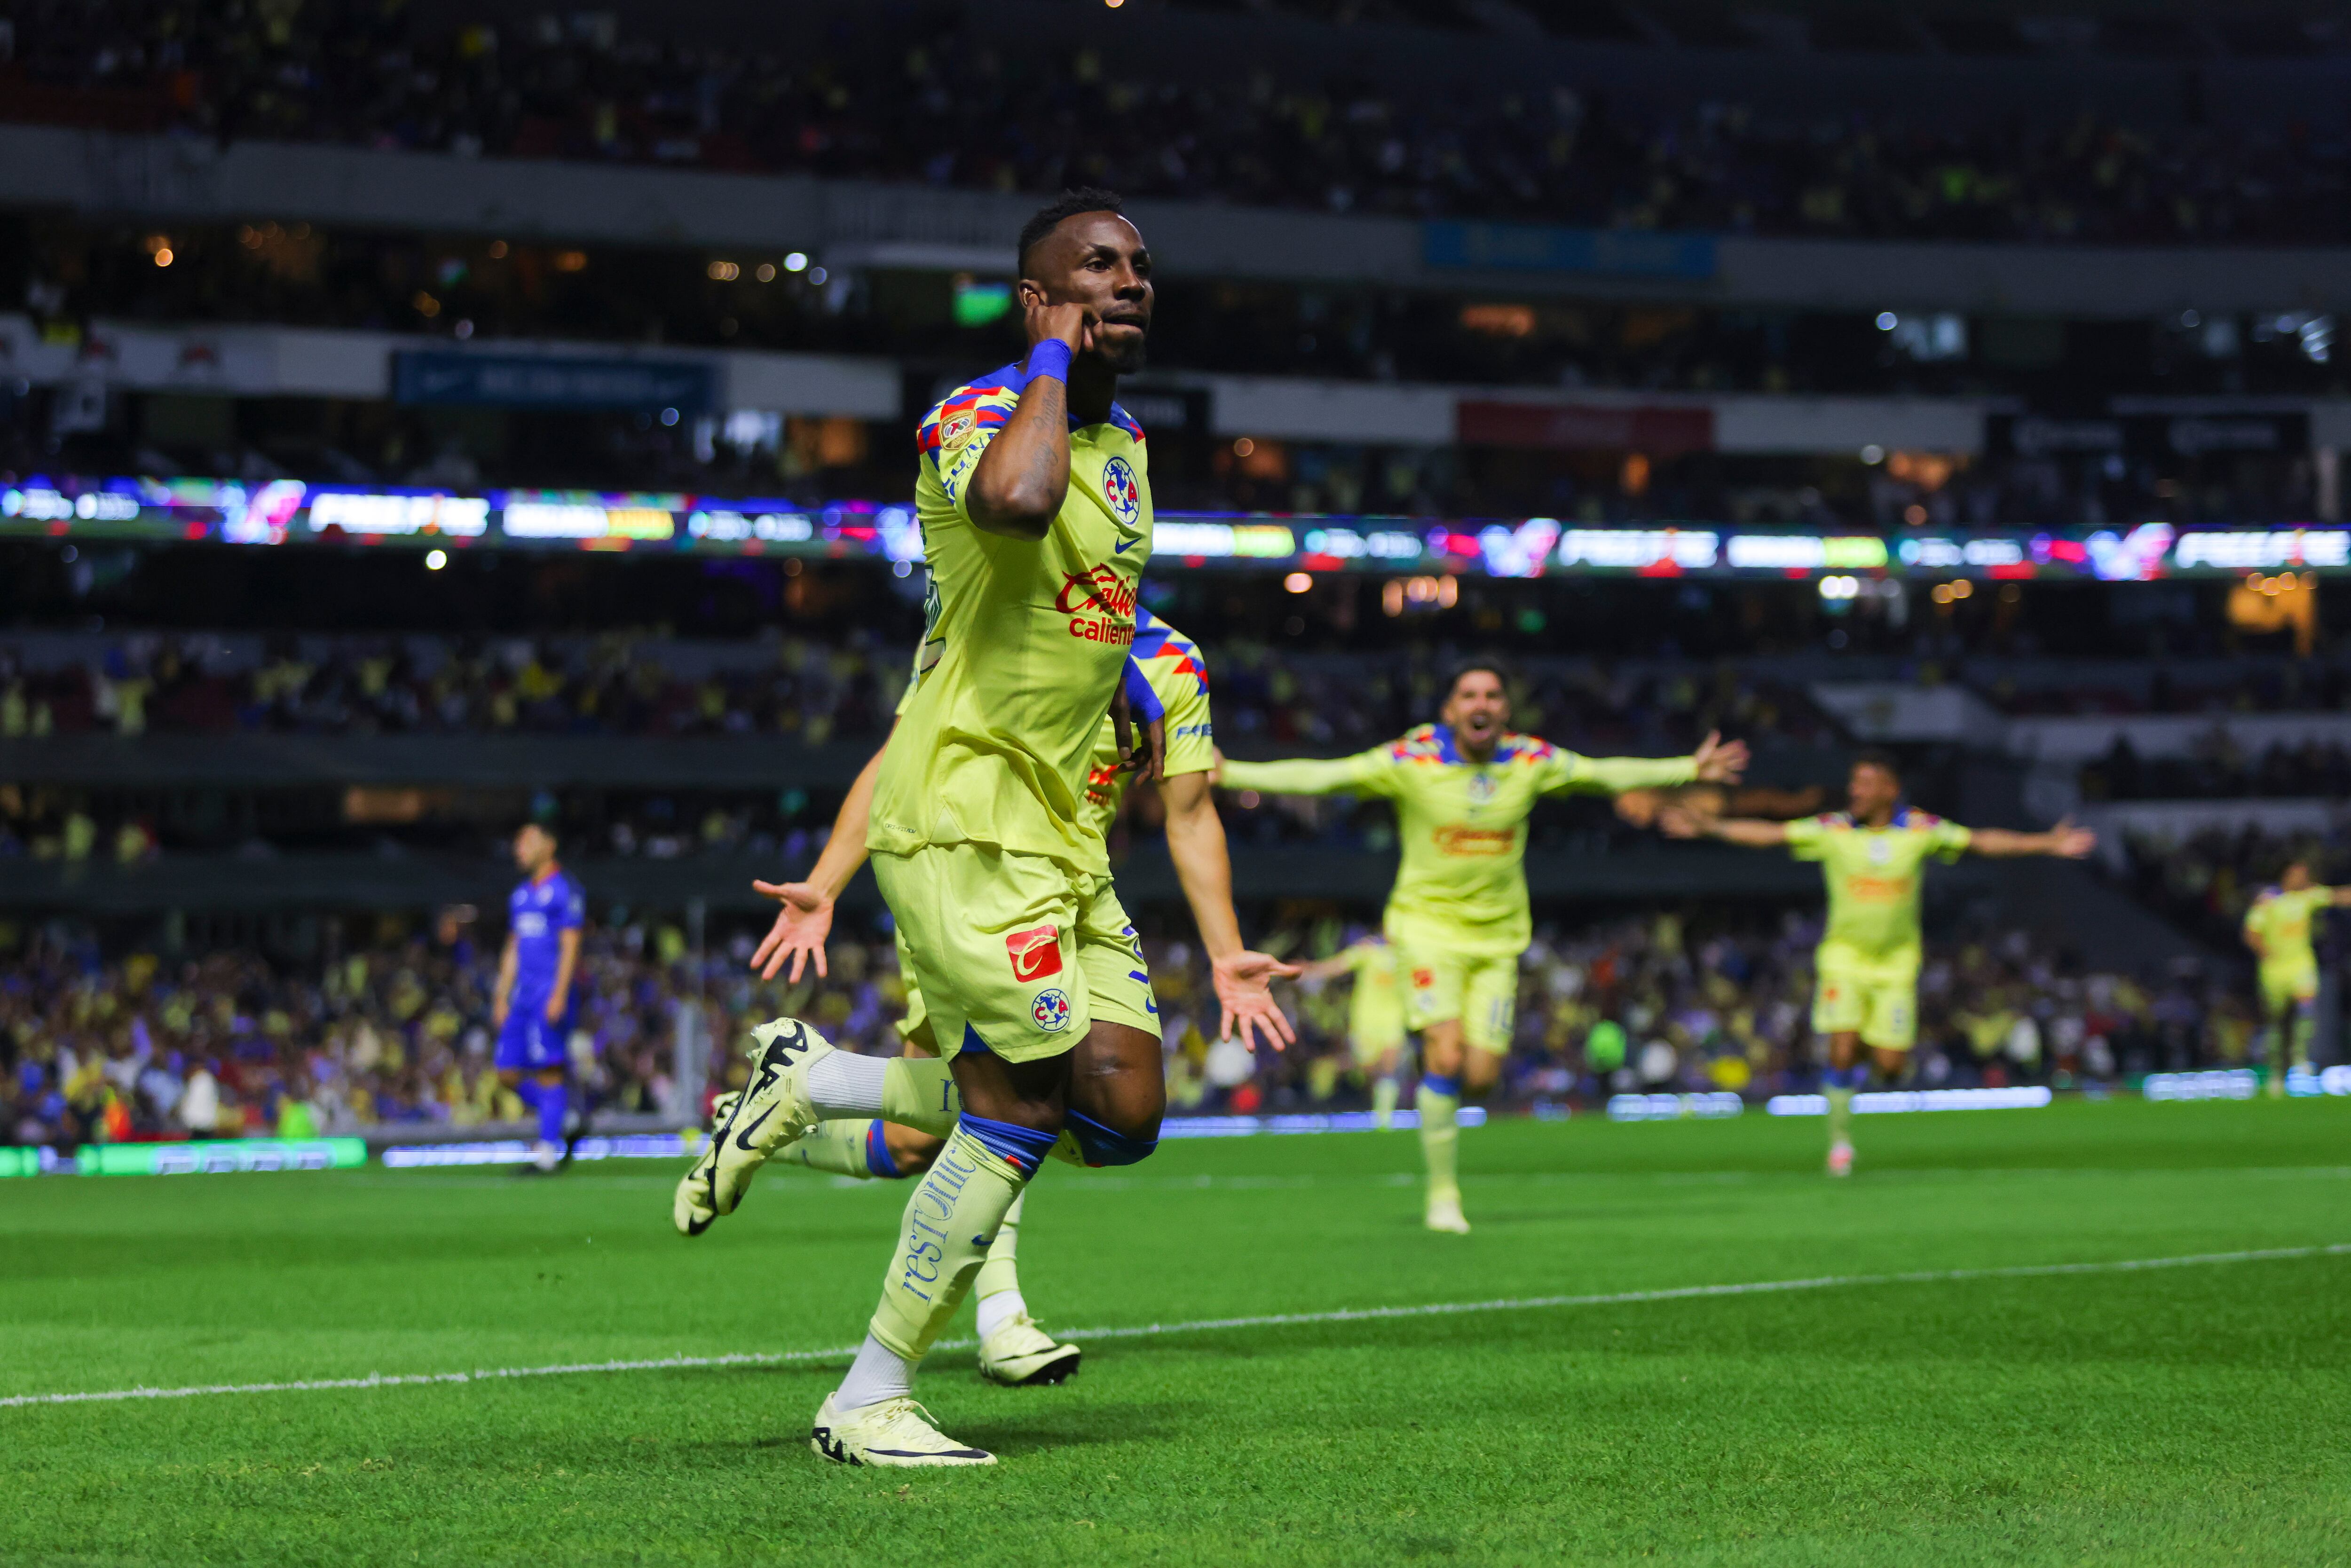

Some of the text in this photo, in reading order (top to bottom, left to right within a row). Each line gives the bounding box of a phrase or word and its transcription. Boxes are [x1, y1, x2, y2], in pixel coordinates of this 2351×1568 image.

[1106, 480, 1138, 502] C A
[1035, 1000, 1068, 1020] C A
